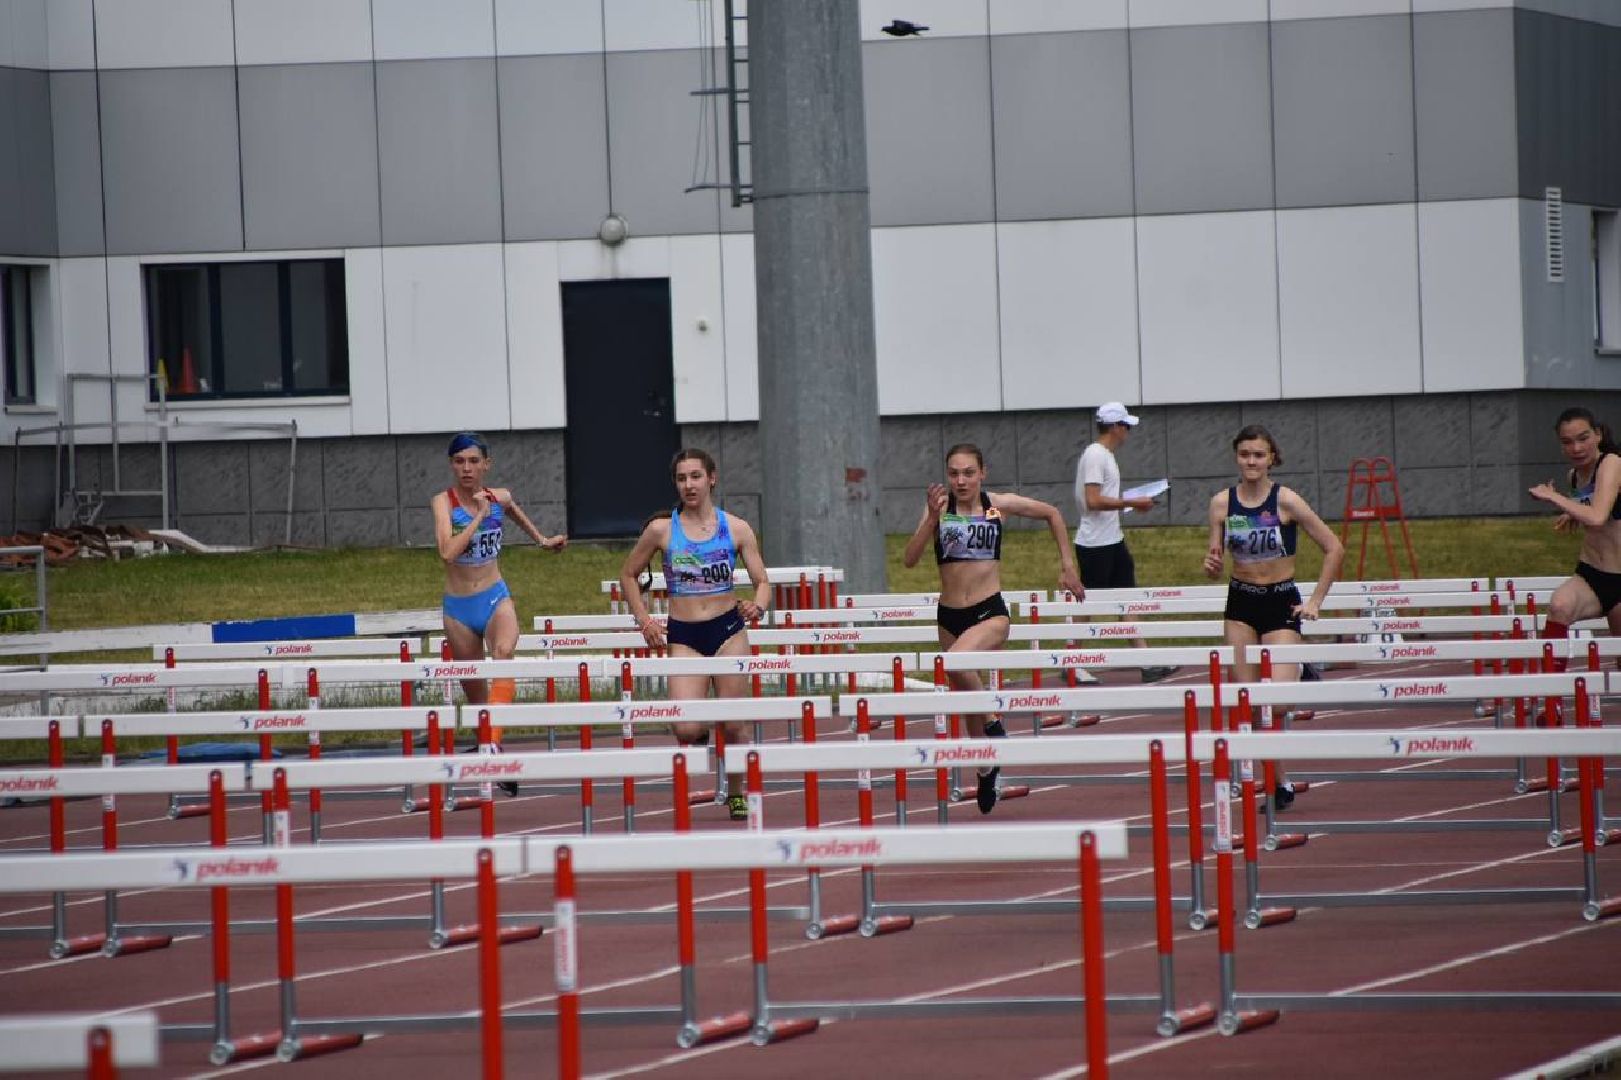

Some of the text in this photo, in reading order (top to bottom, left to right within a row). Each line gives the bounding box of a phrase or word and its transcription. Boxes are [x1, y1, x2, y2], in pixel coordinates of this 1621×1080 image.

[967, 524, 994, 549] 290
[1249, 528, 1276, 554] 276
[1099, 625, 1137, 636] polanik
[1383, 620, 1421, 632] polanik
[550, 635, 588, 648] polanik
[823, 630, 861, 642] polanik
[275, 644, 313, 656] polanik
[1392, 646, 1437, 658] polanik
[748, 658, 791, 671] polanik
[1061, 654, 1105, 667] polanik
[435, 664, 477, 678] polanik
[112, 672, 157, 685] polanik
[1394, 683, 1448, 697] polanik
[1008, 695, 1062, 709] polanik
[630, 706, 681, 720] polanik
[253, 714, 306, 729] polanik
[1407, 737, 1474, 753] polanik
[935, 746, 997, 762] polanik
[459, 760, 523, 778] polanik
[800, 838, 883, 861] polanik
[197, 857, 279, 880] polanik
